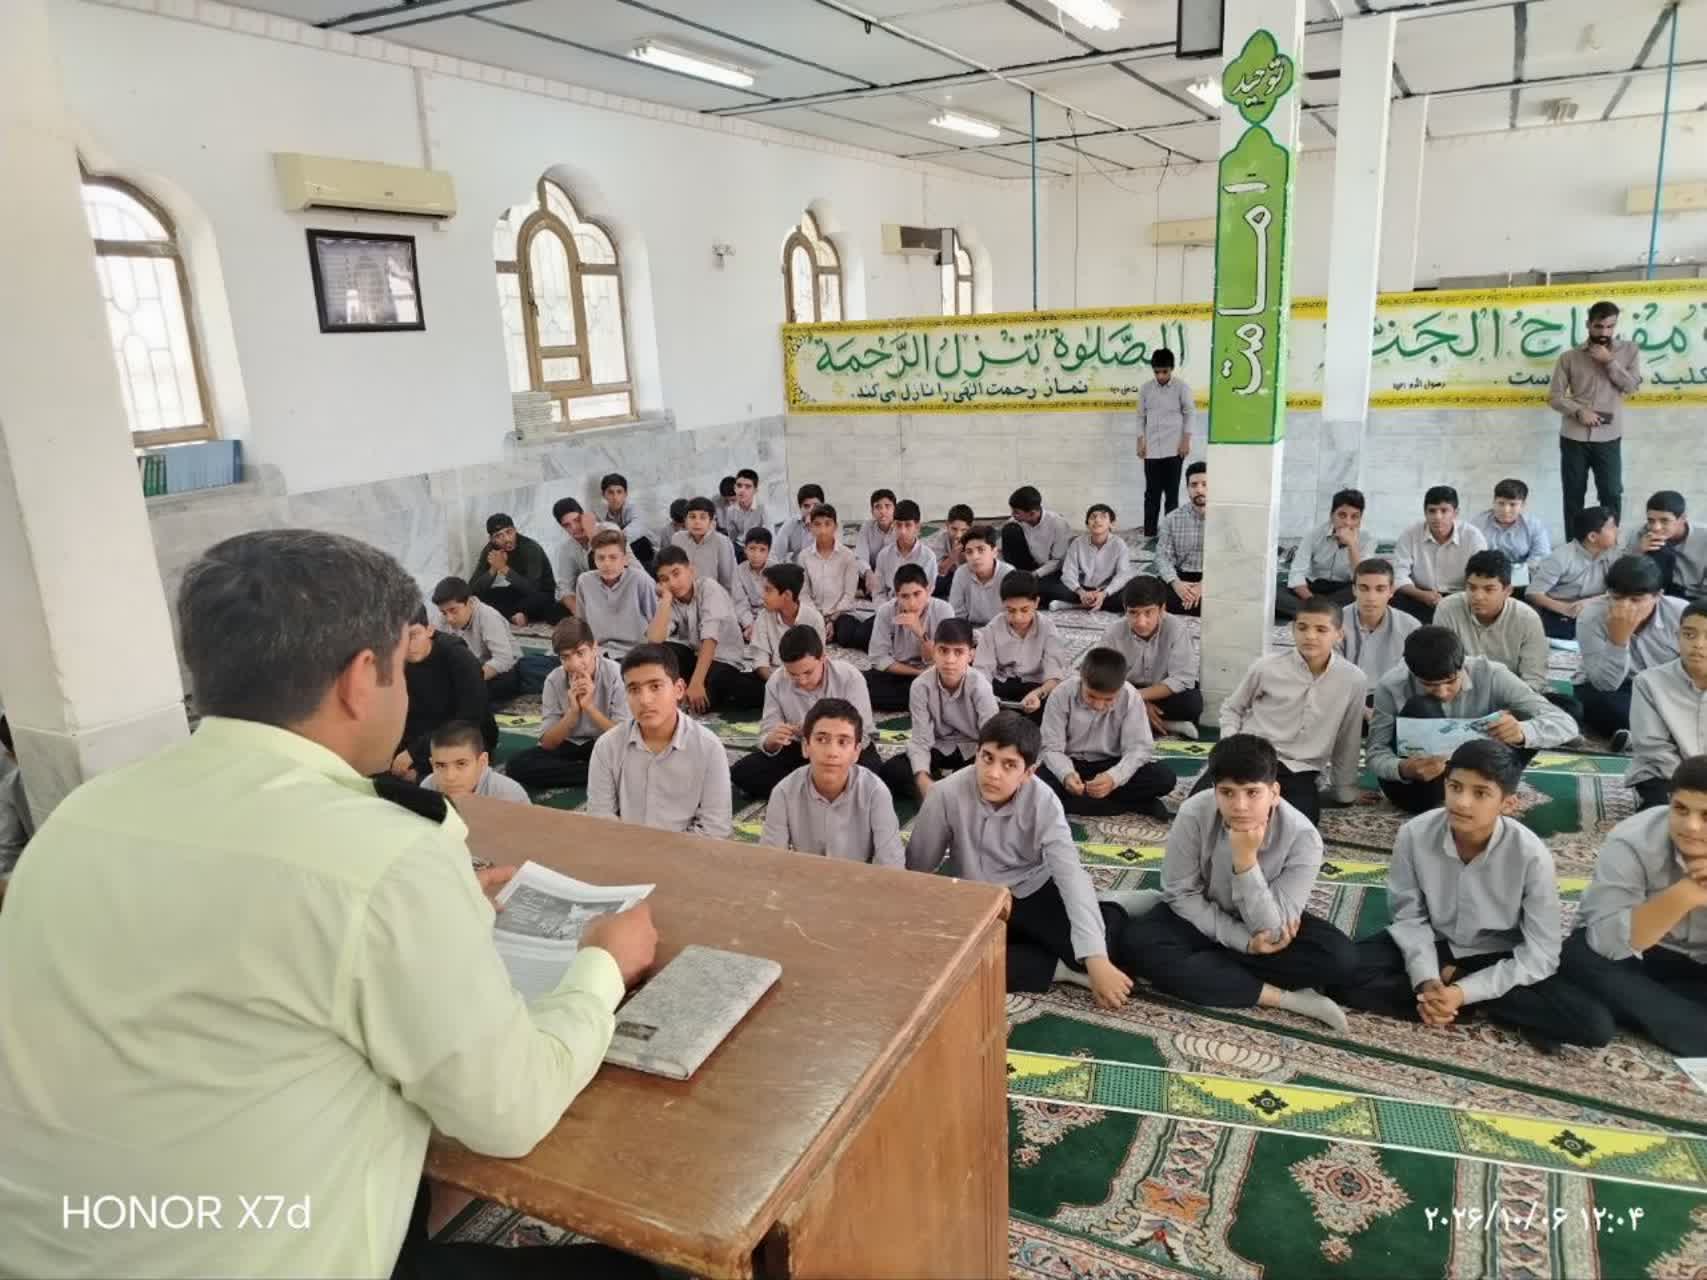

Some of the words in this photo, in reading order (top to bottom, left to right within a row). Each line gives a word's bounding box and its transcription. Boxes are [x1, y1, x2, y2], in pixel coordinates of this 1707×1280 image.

[1231, 58, 1284, 108] توحید
[1042, 377, 1089, 397] نماز
[1507, 371, 1552, 385] ست
[900, 383, 935, 401] نازل
[937, 383, 950, 402] را
[985, 381, 1037, 400] رحمت
